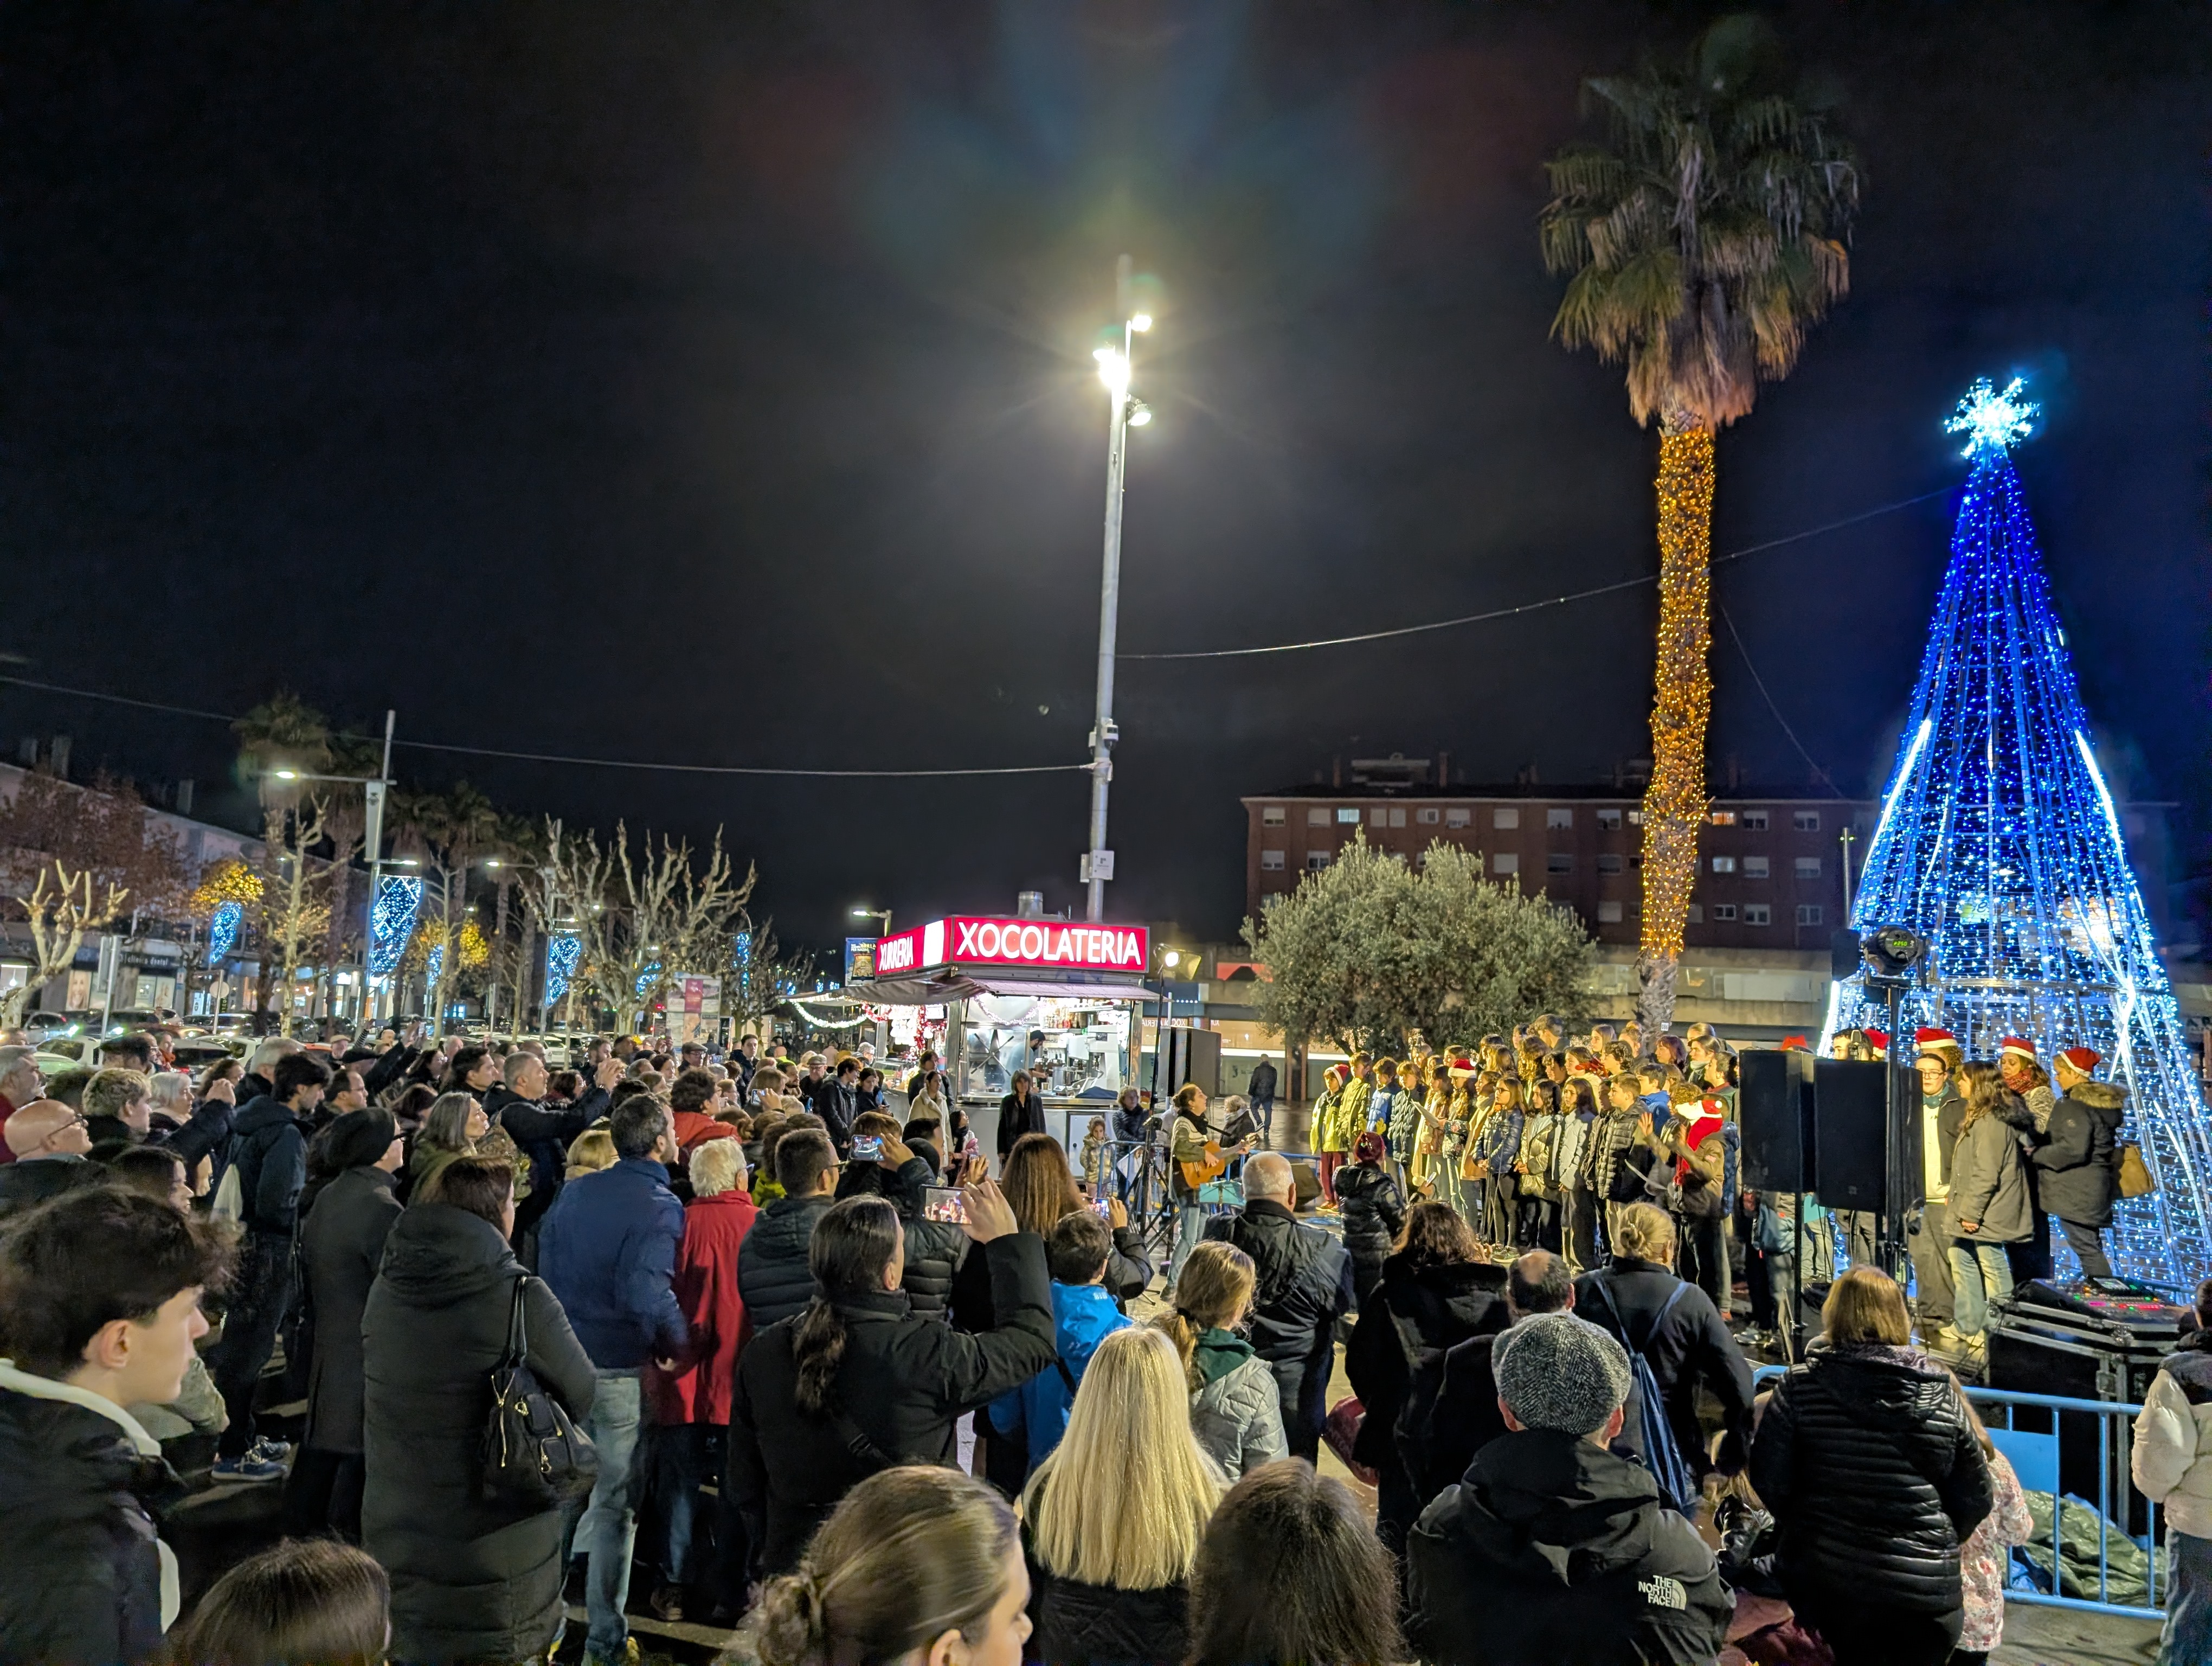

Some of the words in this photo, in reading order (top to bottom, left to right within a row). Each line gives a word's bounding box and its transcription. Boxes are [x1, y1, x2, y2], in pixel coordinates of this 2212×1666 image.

[878, 935, 914, 971] XURRERIA
[956, 922, 1141, 965] XOCOLATERIA
[1638, 1581, 1671, 1600] NORTH
[1652, 1575, 1673, 1588] THE
[1648, 1593, 1671, 1607] FACE
